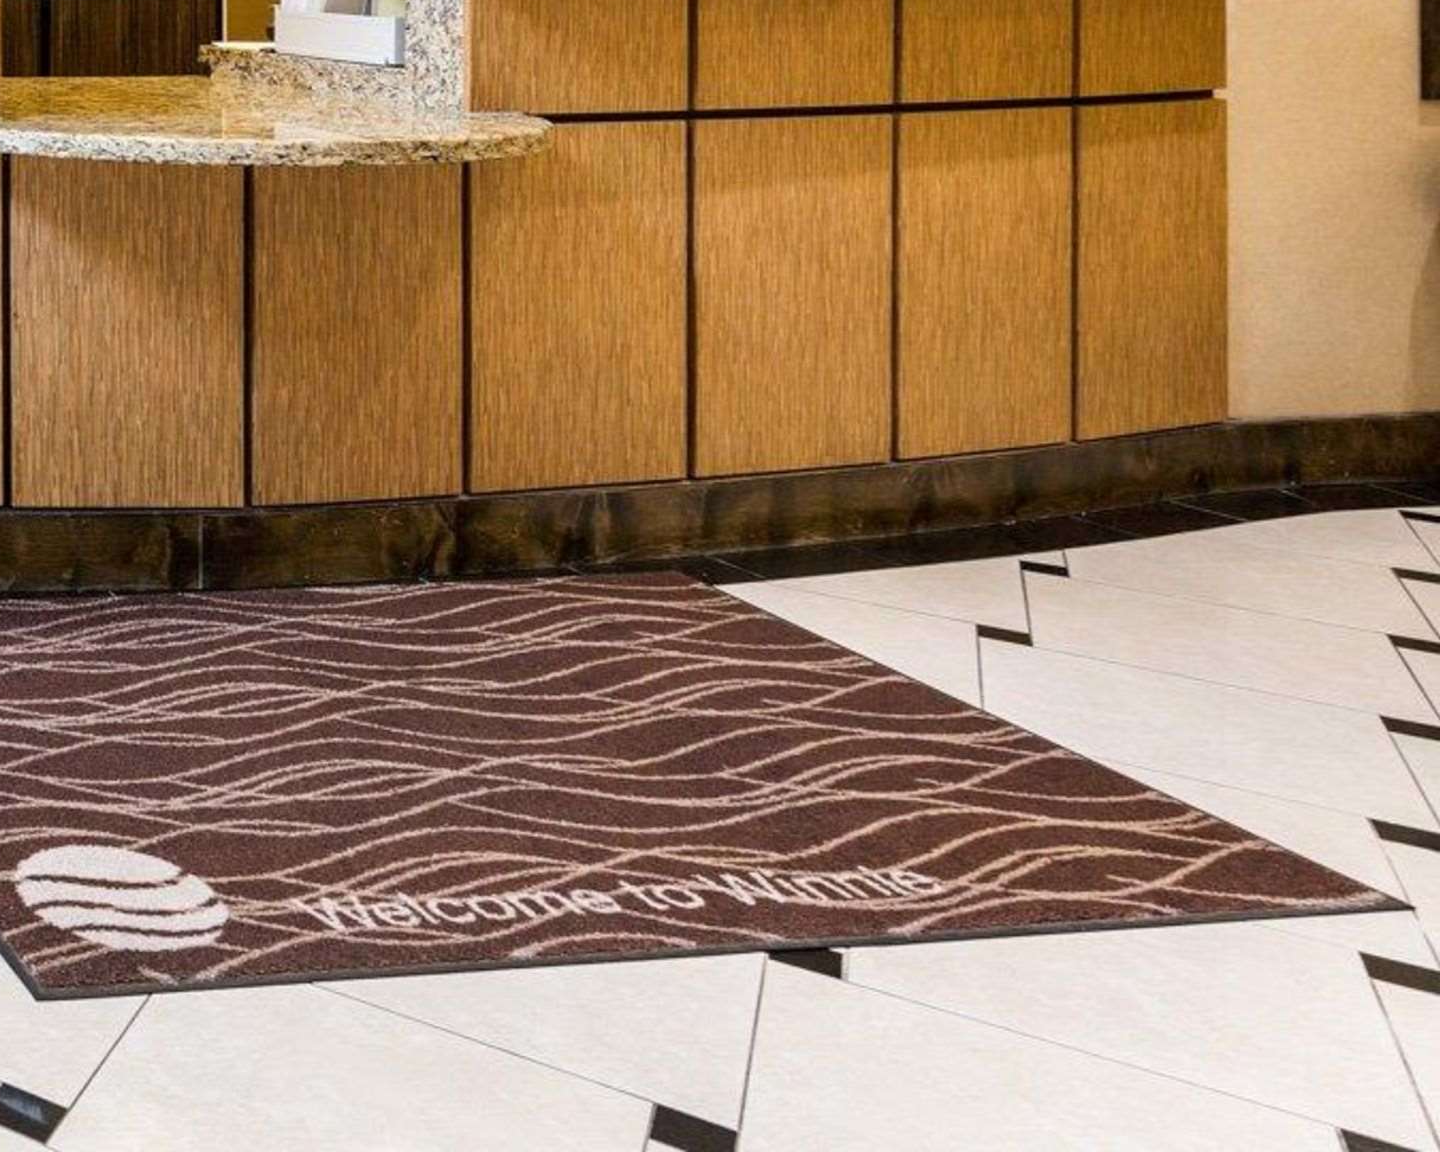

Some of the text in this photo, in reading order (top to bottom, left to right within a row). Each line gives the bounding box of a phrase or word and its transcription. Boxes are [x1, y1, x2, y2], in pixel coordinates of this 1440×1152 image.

[293, 864, 942, 932] Welcome to Winnie
